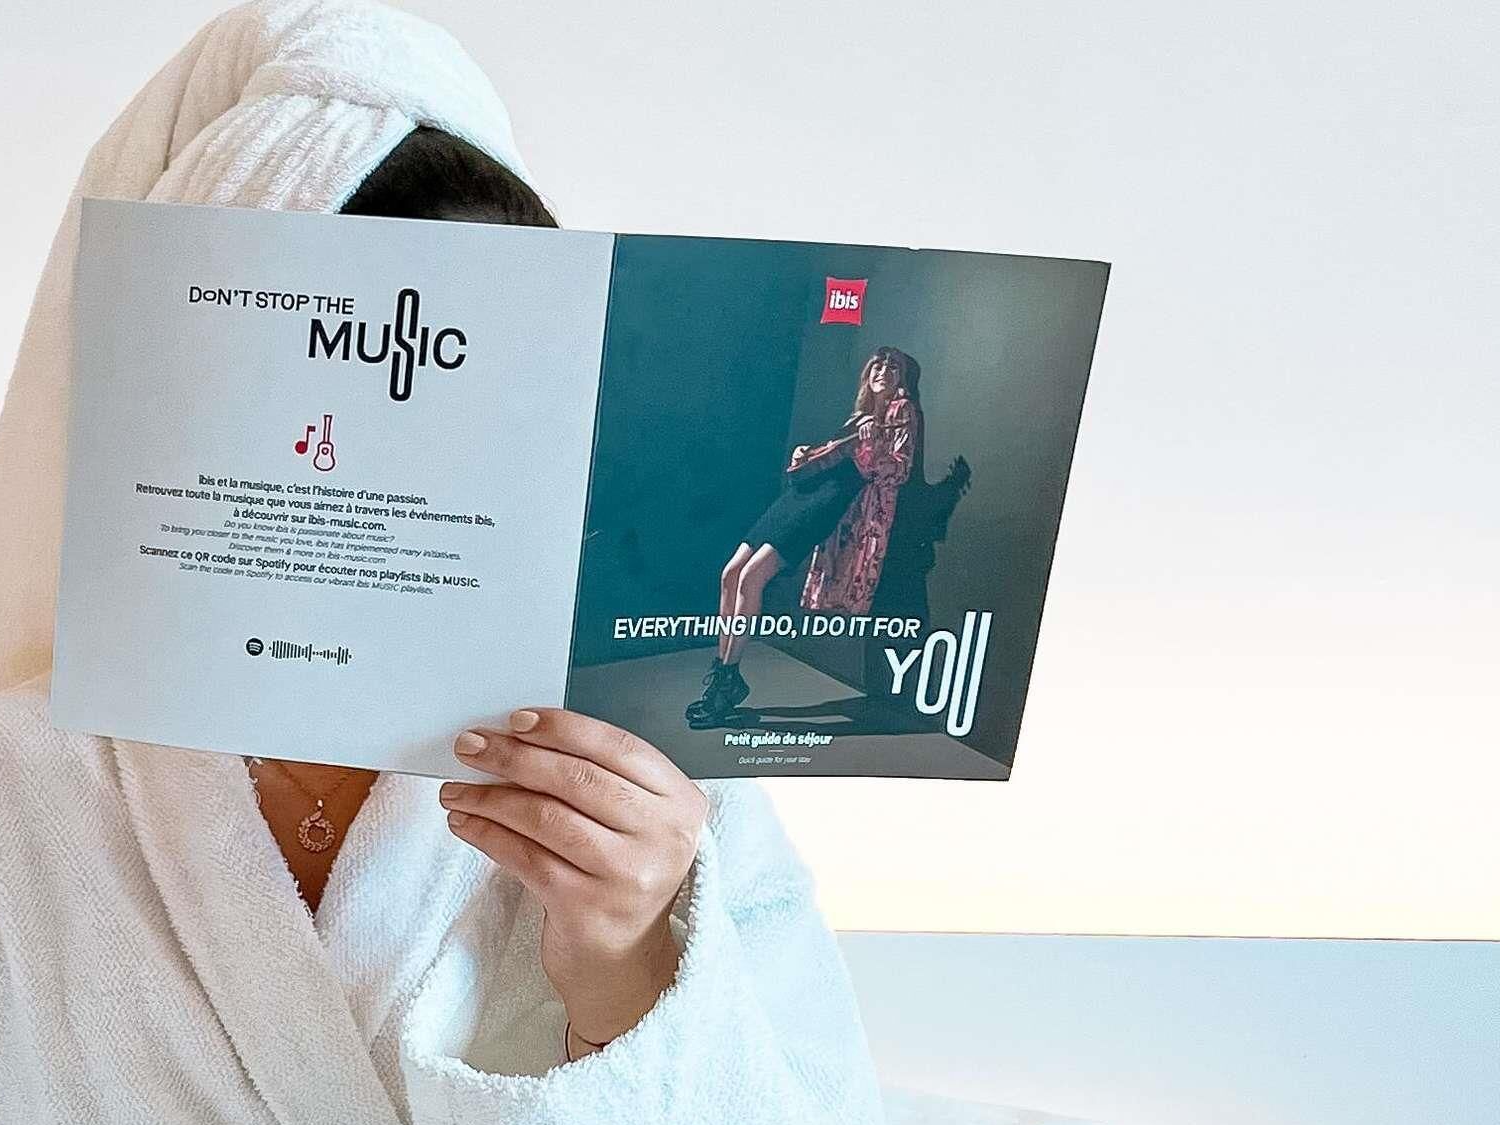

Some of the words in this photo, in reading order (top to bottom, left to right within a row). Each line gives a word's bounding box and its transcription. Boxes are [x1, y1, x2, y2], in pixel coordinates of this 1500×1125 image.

[255, 292, 309, 312] STOP
[313, 295, 355, 315] THE
[829, 289, 859, 310] ibis
[307, 288, 468, 402] MUSIC
[136, 483, 183, 498] Retrouvez
[185, 489, 211, 501] toute
[213, 490, 221, 501] la
[223, 493, 264, 507] musique
[267, 498, 285, 509] que
[288, 499, 311, 510] vous
[314, 501, 344, 513] aimez
[355, 506, 389, 517] travers
[392, 507, 406, 518] les
[409, 508, 472, 525] événements
[217, 476, 228, 487] et
[230, 478, 238, 488] la
[240, 481, 284, 494] musique,
[287, 483, 311, 495] c'est
[313, 486, 354, 499] l'histoire
[357, 489, 384, 501] d'une
[387, 493, 428, 505] passion.
[242, 508, 289, 522] découvrir
[291, 514, 306, 523] sur
[140, 545, 178, 559] Scannez
[180, 550, 192, 560] ce
[195, 552, 209, 562] QR
[211, 553, 236, 565] code
[238, 557, 253, 565] sur
[255, 557, 291, 571] Spotify
[293, 562, 315, 573] pour
[318, 563, 357, 576] écouter
[359, 568, 377, 578] nos
[379, 569, 420, 582] playlists
[443, 575, 480, 588] MUSIC.
[614, 615, 746, 640] EVERYTHING
[749, 615, 758, 636] I
[761, 616, 798, 640] DO,
[802, 616, 809, 636] I
[813, 616, 846, 637] DO
[848, 616, 871, 637] IT
[873, 617, 921, 638] FOR
[884, 611, 993, 737] YOU
[724, 733, 750, 746] Petit
[751, 732, 781, 747] guide
[782, 732, 797, 745] de
[798, 732, 833, 747] séjour
